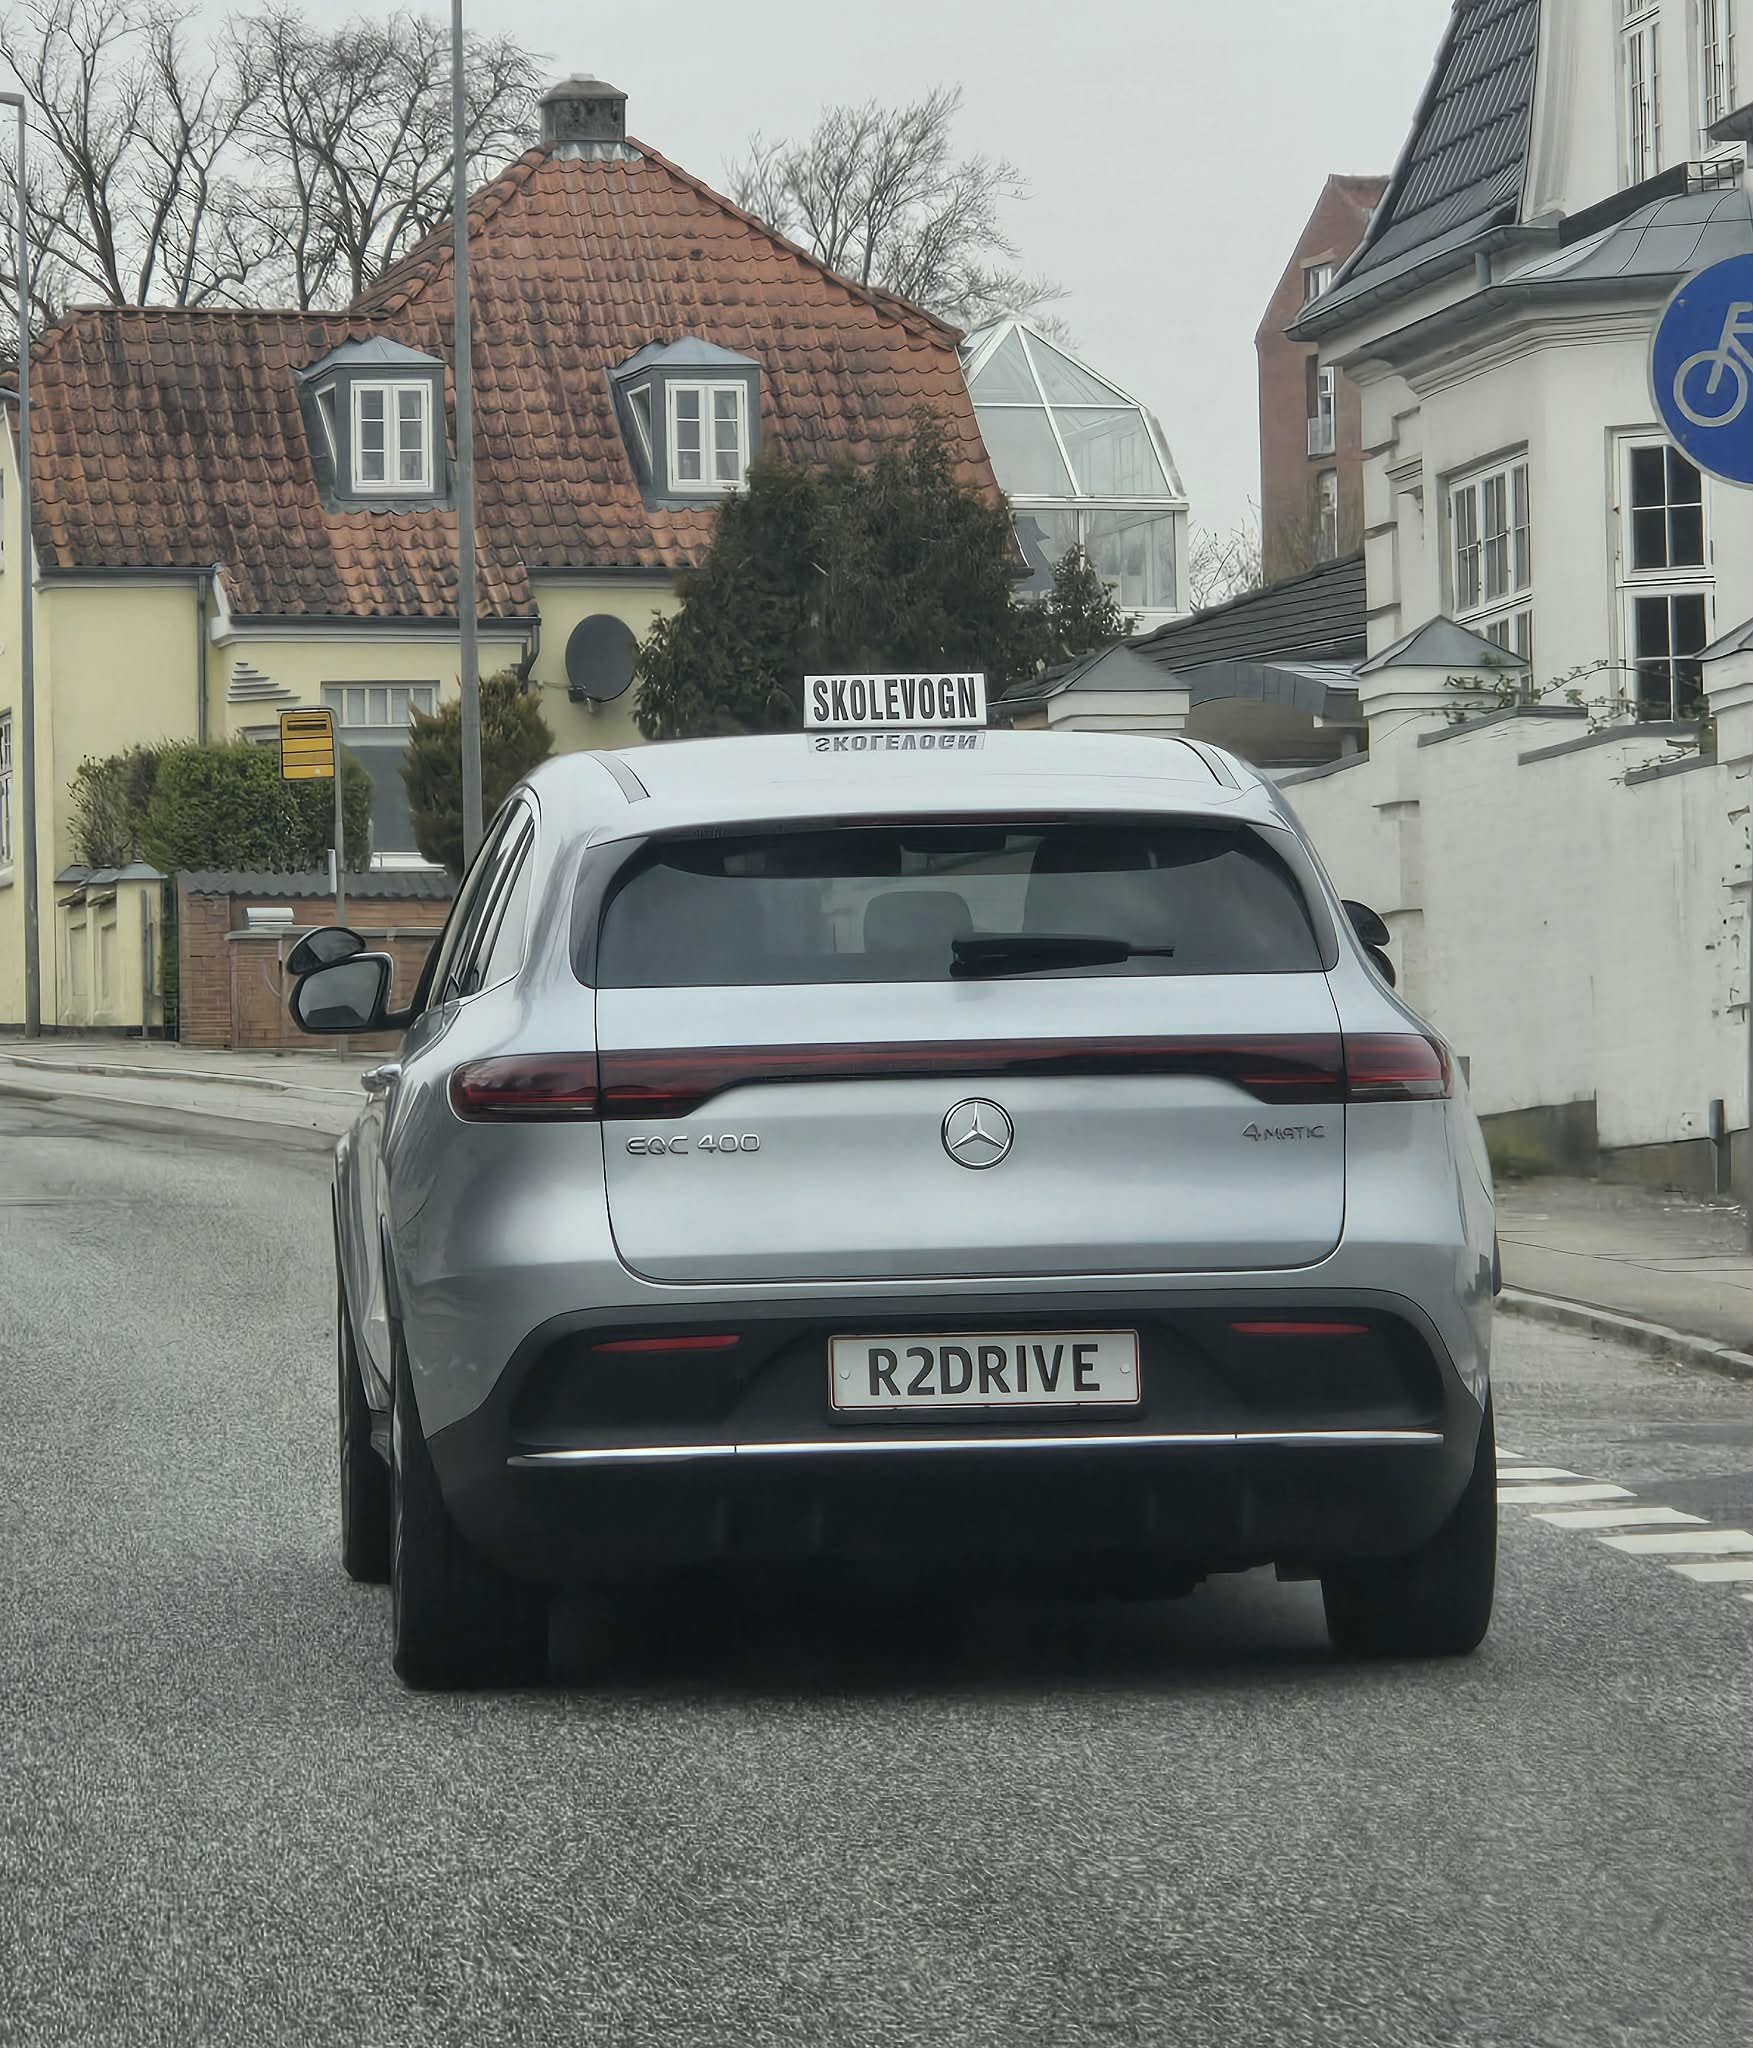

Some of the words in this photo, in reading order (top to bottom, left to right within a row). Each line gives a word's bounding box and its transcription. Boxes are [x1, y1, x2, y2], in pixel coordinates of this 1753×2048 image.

[812, 676, 978, 722] SKOLEVOGN
[626, 1135, 689, 1156] EQC
[697, 1133, 761, 1154] 400
[867, 1343, 1101, 1397] R2DRIVE
